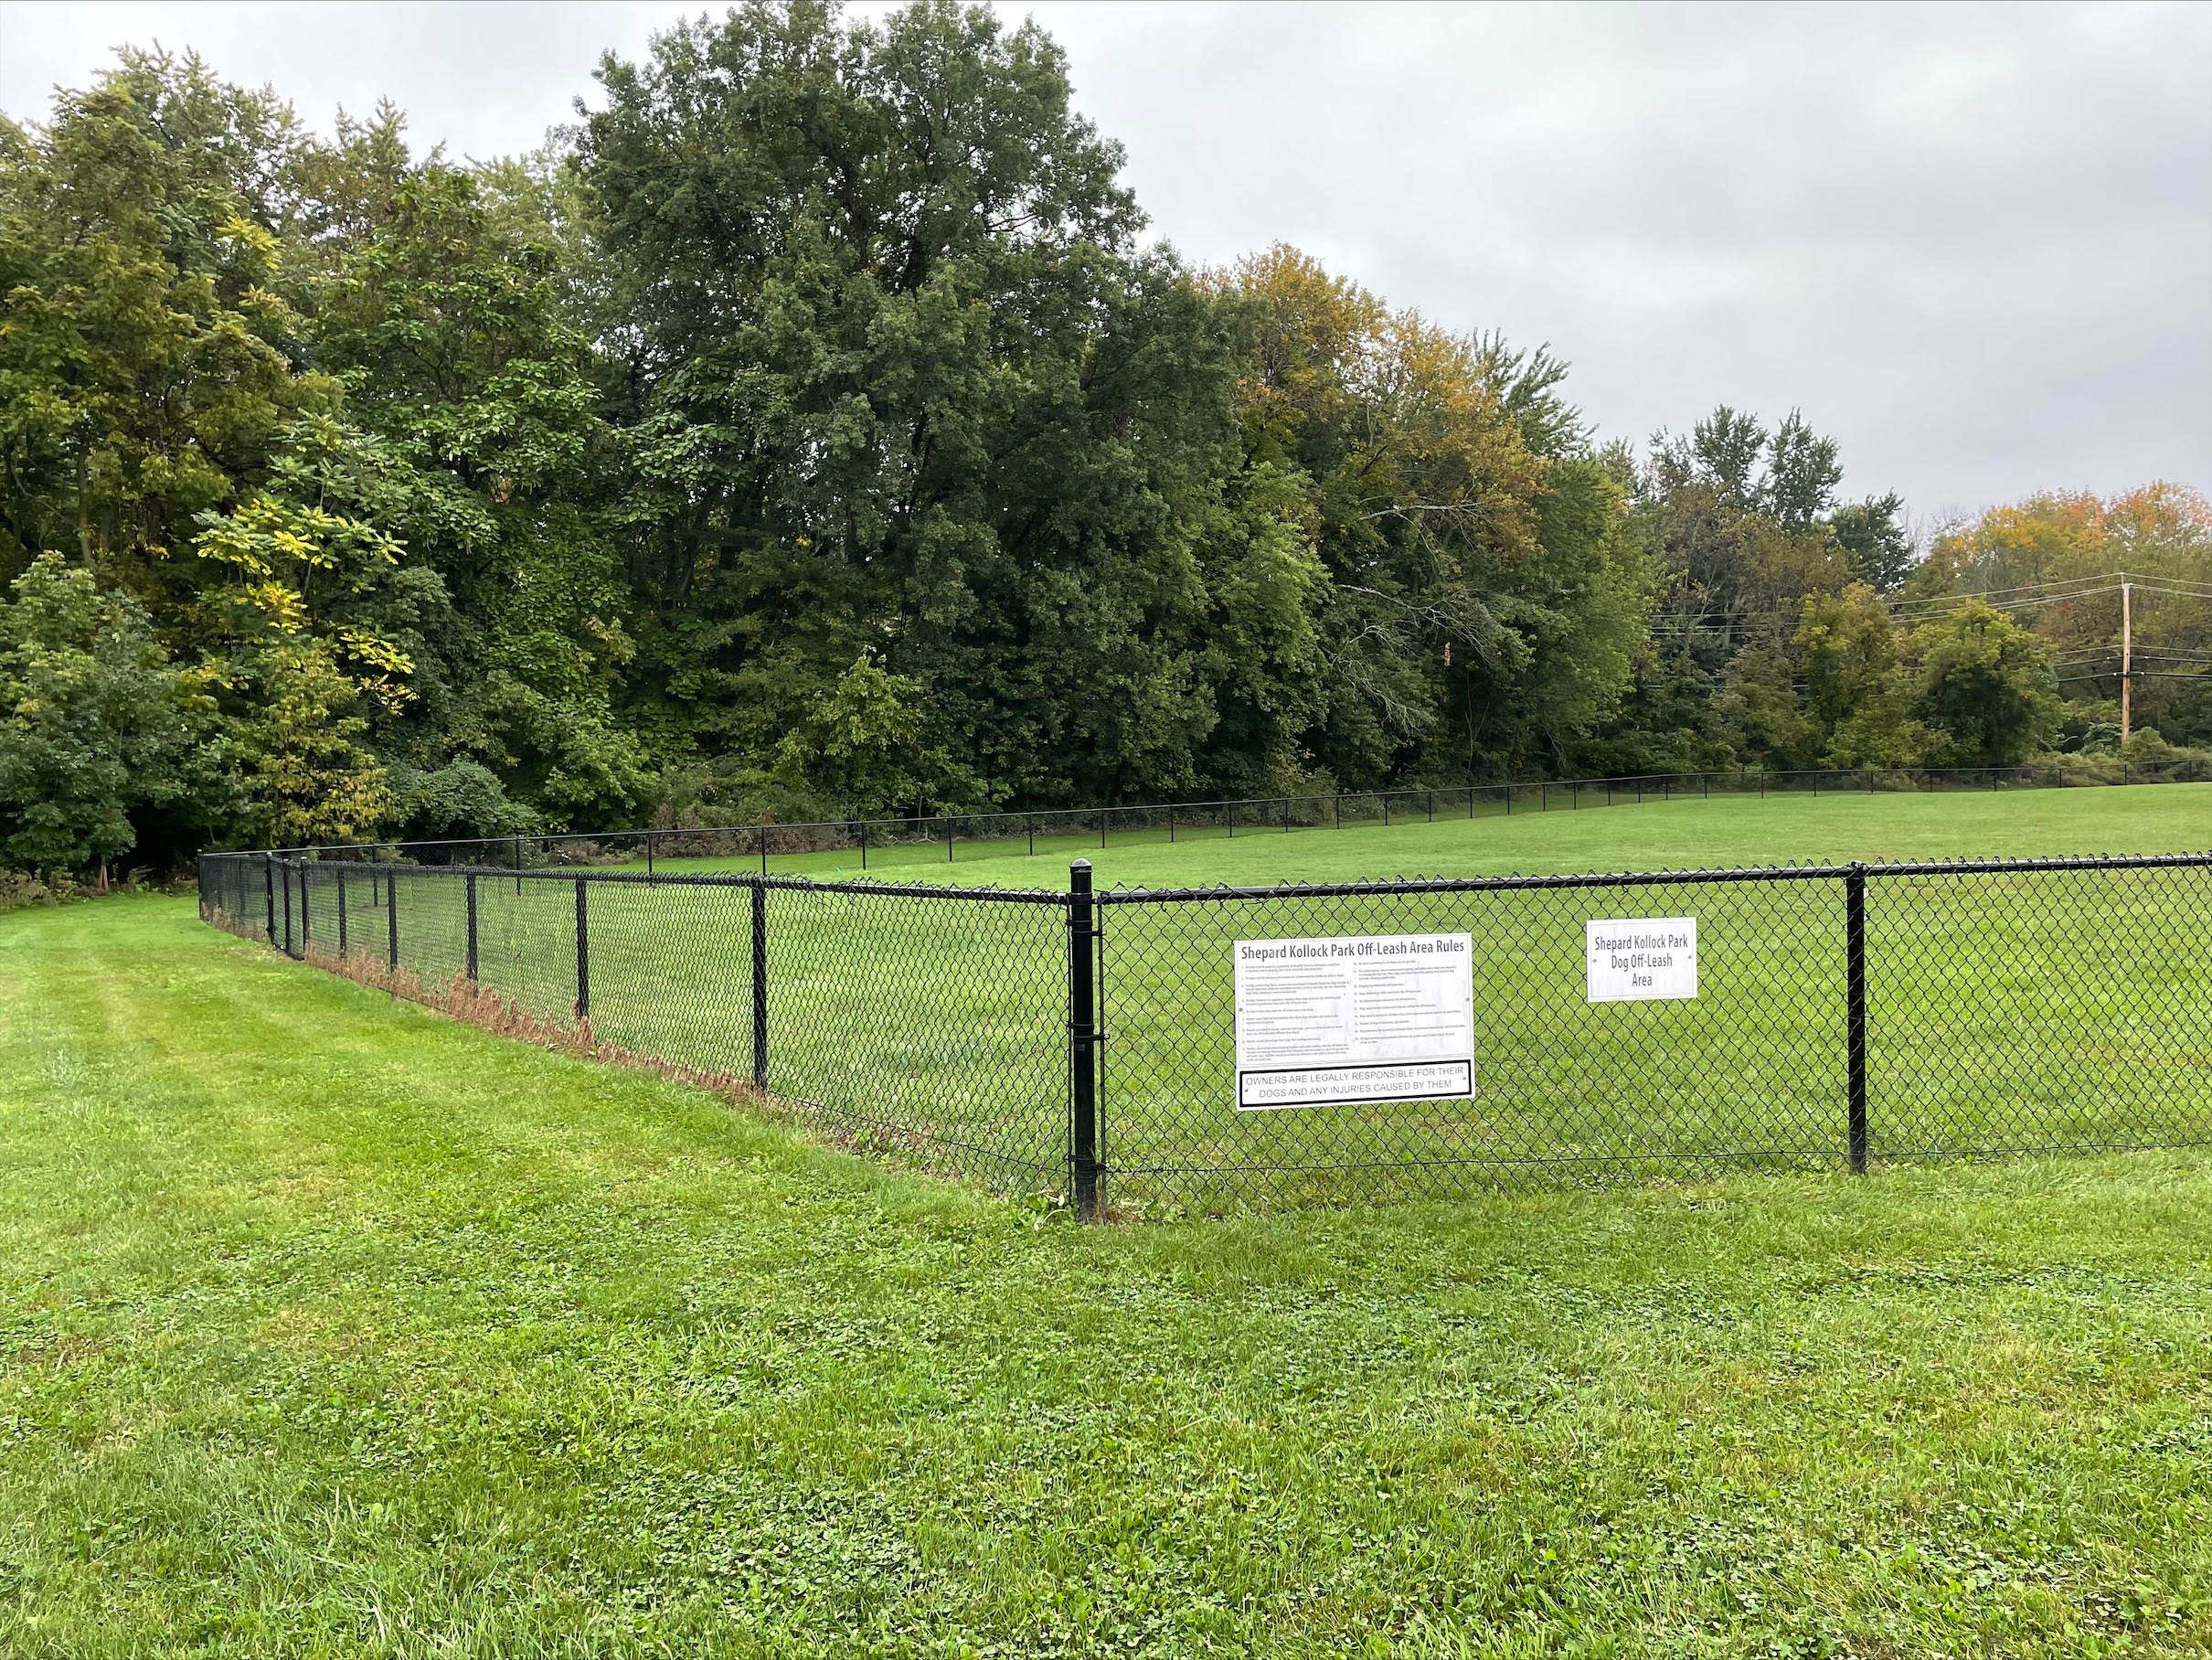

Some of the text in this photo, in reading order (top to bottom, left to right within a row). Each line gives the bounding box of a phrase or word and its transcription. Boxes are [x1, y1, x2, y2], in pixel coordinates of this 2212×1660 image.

[1241, 939, 1463, 962] Shepard Kollock Park Off-Leash Area Rules
[1595, 933, 1687, 952] Shepard Kollock Park
[1611, 953, 1672, 972] Dog Off-Leash
[1632, 973, 1653, 986] Area
[1246, 1066, 1463, 1085] OWNERS ARE LEGALLY RESPONSIBLE FOR THEIR
[1260, 1080, 1452, 1098] DOGS AND ANY INJURIES CAUSED BY THEM
